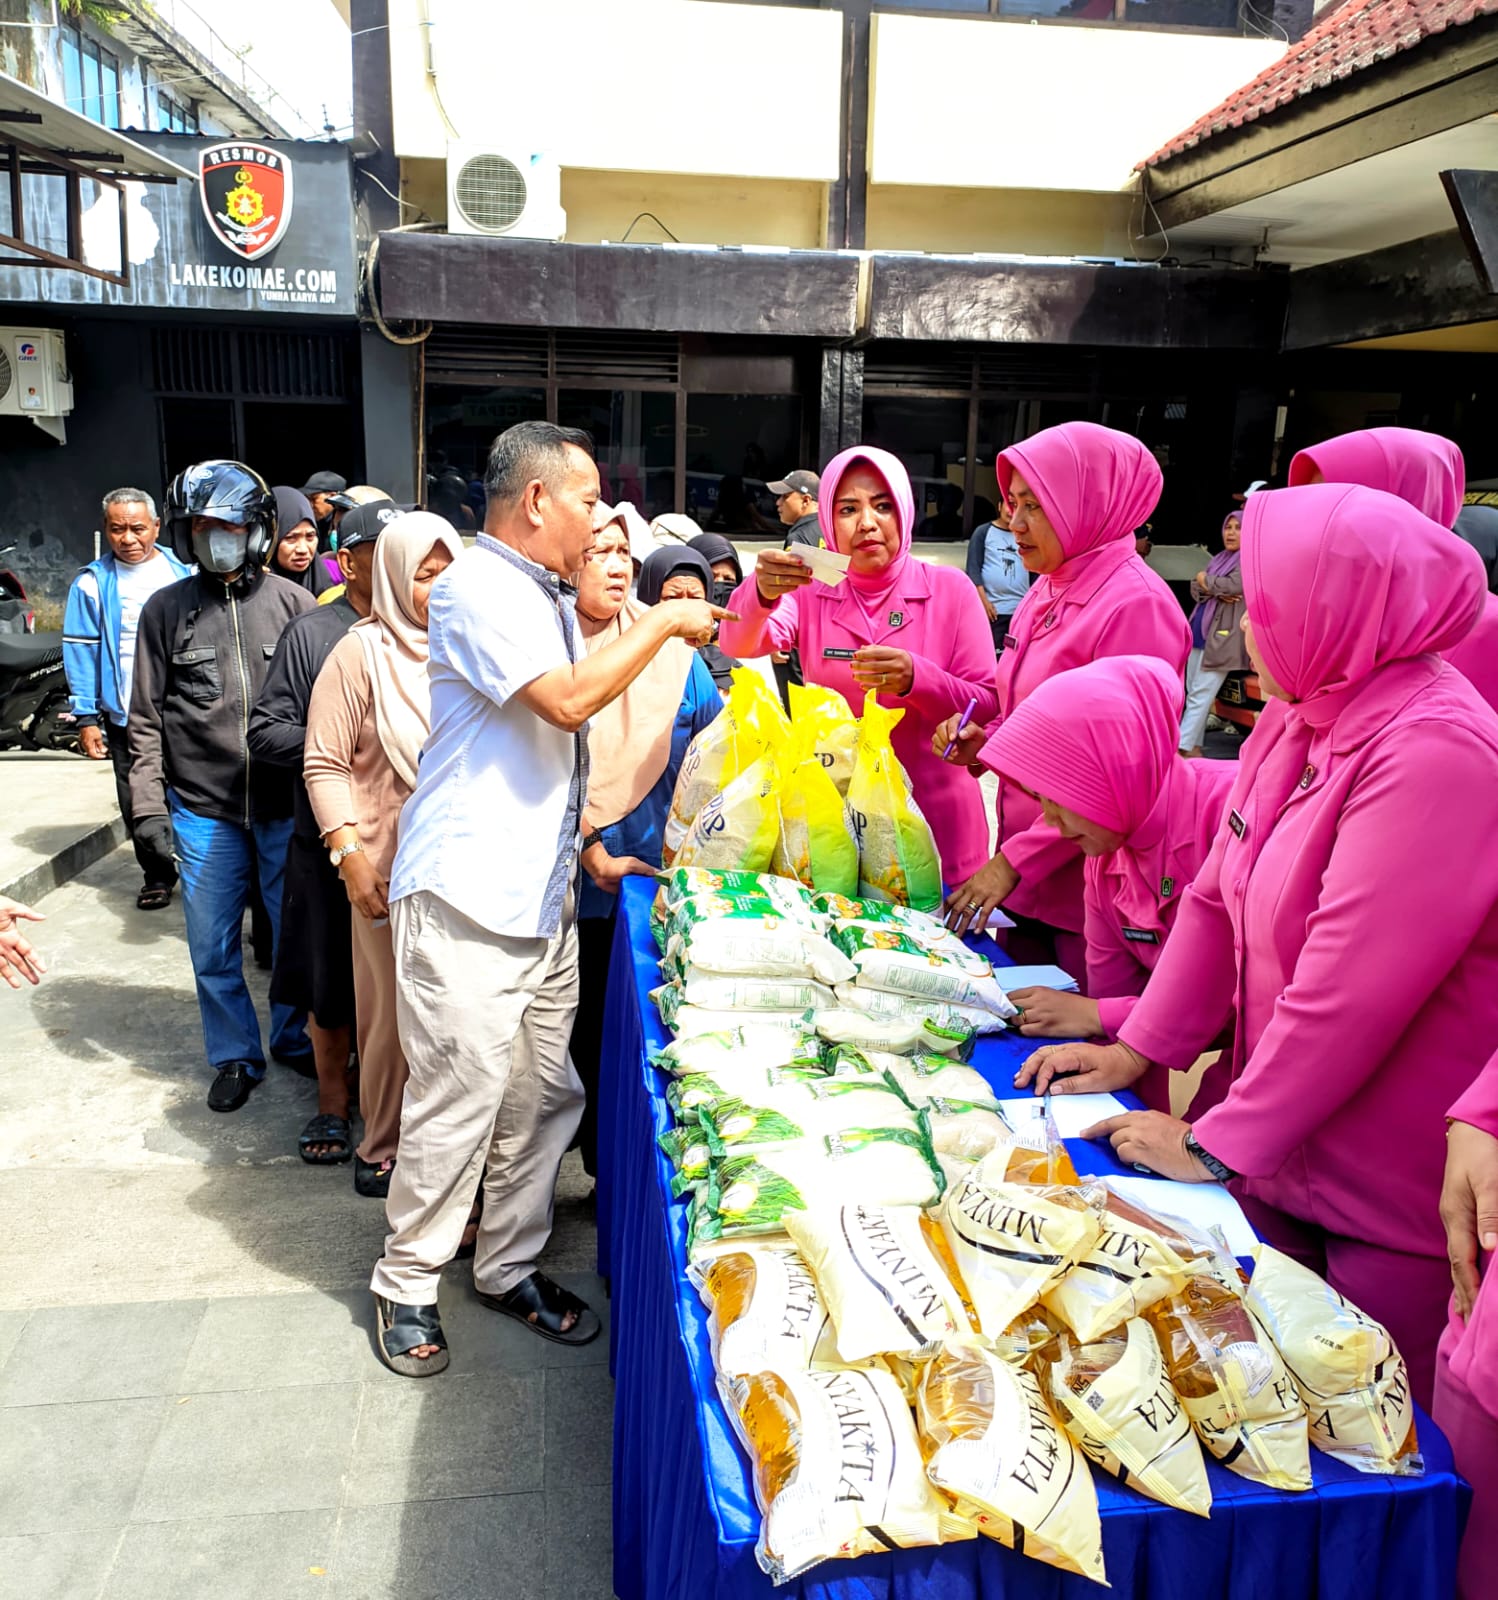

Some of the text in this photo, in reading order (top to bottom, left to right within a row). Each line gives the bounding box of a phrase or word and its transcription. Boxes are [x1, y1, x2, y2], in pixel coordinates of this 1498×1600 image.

[210, 147, 278, 168] RESMOB
[170, 263, 337, 292] LAKEKOMAE.COM
[290, 291, 318, 303] KARYA
[319, 293, 336, 304] ADV
